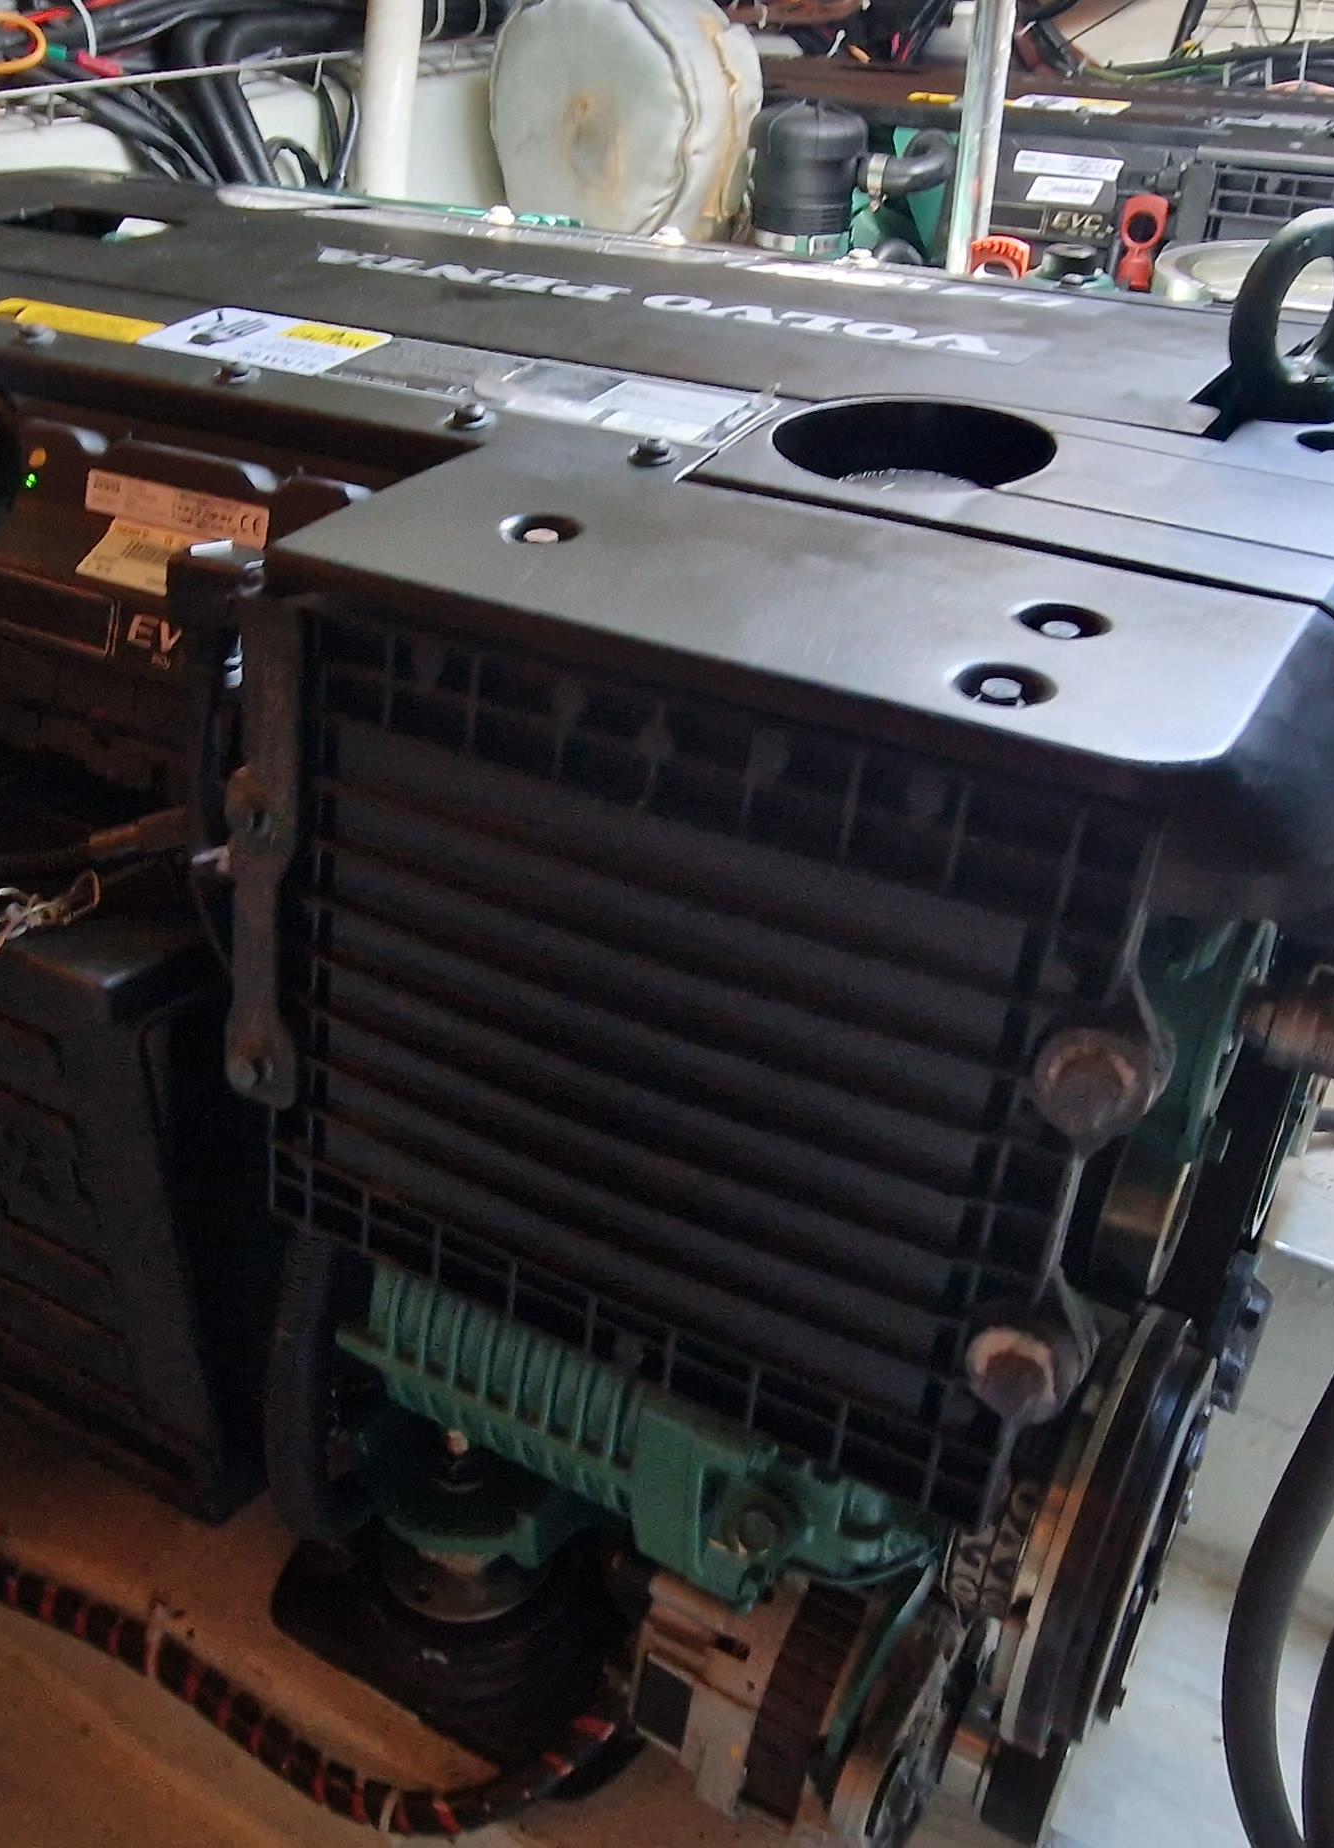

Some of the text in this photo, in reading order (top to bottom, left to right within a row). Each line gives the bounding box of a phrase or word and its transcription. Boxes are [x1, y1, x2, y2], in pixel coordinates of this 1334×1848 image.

[1051, 210, 1104, 231] EVC
[316, 246, 1002, 356] VOLVO PENTA
[126, 612, 183, 652] EV
